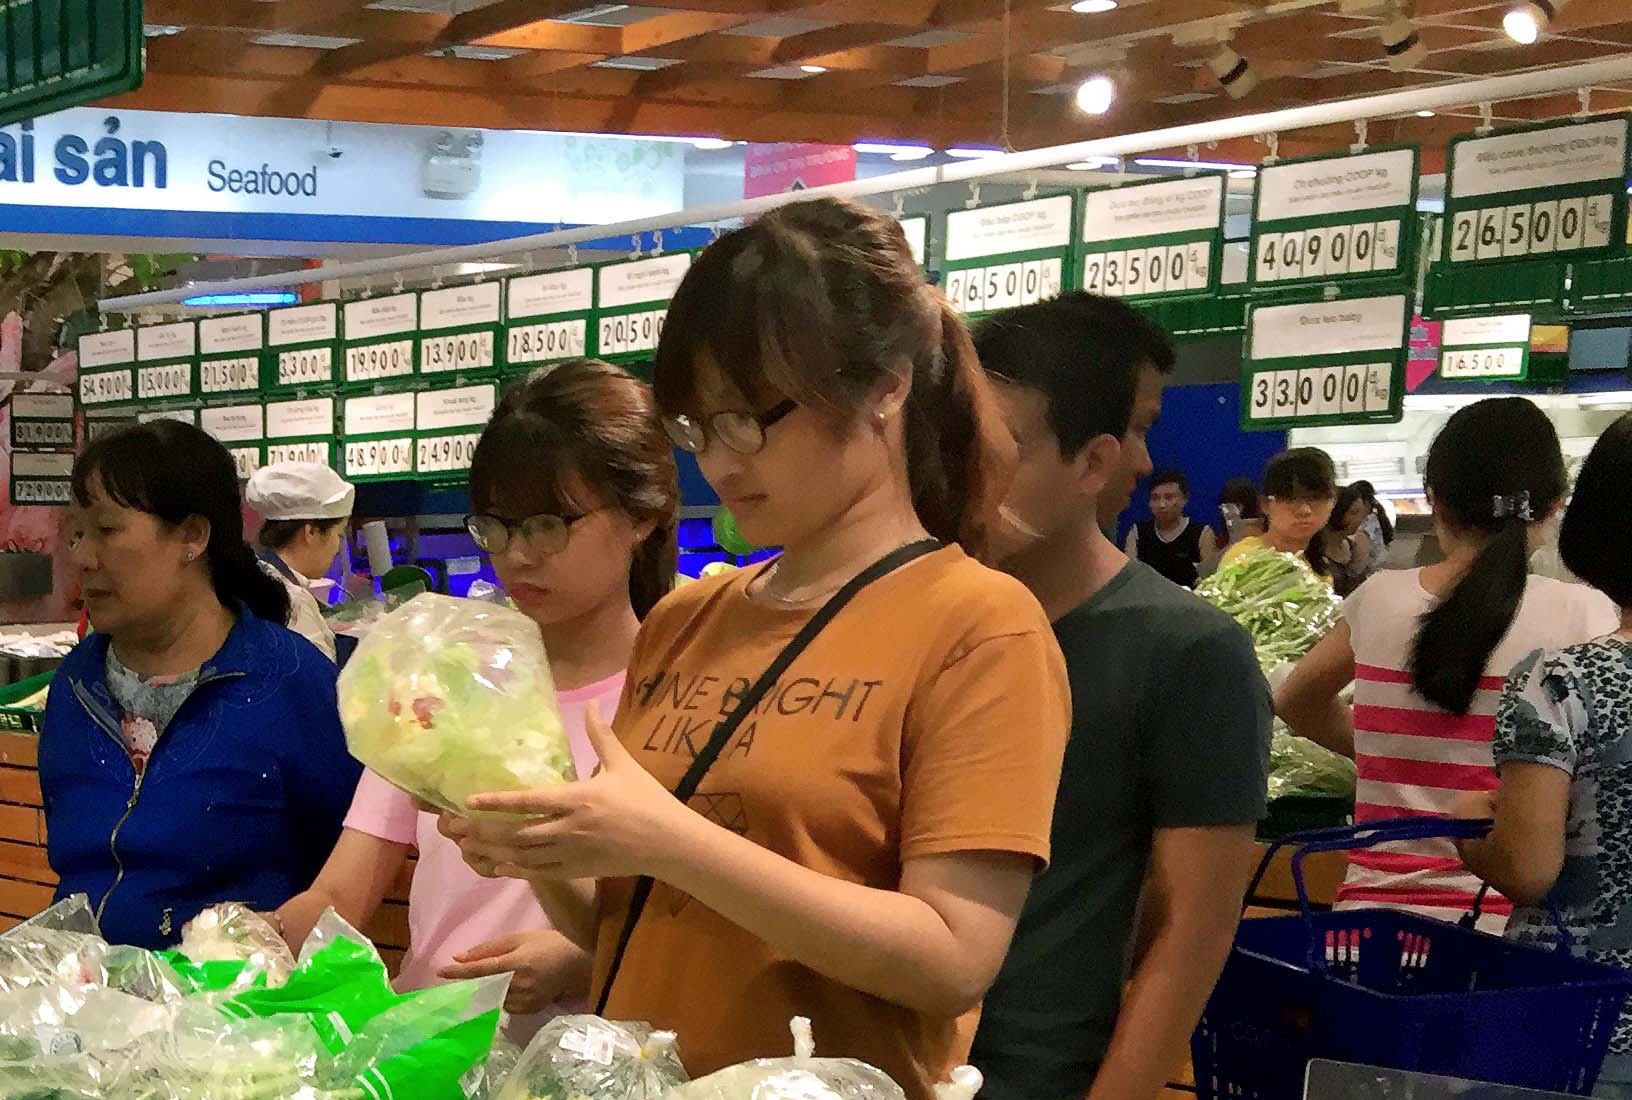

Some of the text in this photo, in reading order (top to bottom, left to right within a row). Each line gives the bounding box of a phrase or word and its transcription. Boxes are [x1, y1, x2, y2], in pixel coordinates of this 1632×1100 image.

[54, 116, 167, 189] sản
[207, 160, 317, 197] Seafood
[1456, 207, 1578, 250] 26.500
[1263, 230, 1369, 270] 40.900
[951, 269, 1037, 305] 26.500
[1089, 252, 1184, 290] 23.500
[425, 339, 477, 366] 13.900
[512, 328, 567, 356] 18.500
[351, 348, 399, 374] 19.900
[1255, 373, 1359, 407] 33.000
[718, 677, 883, 722] BIGHT
[643, 714, 716, 762] LIK
